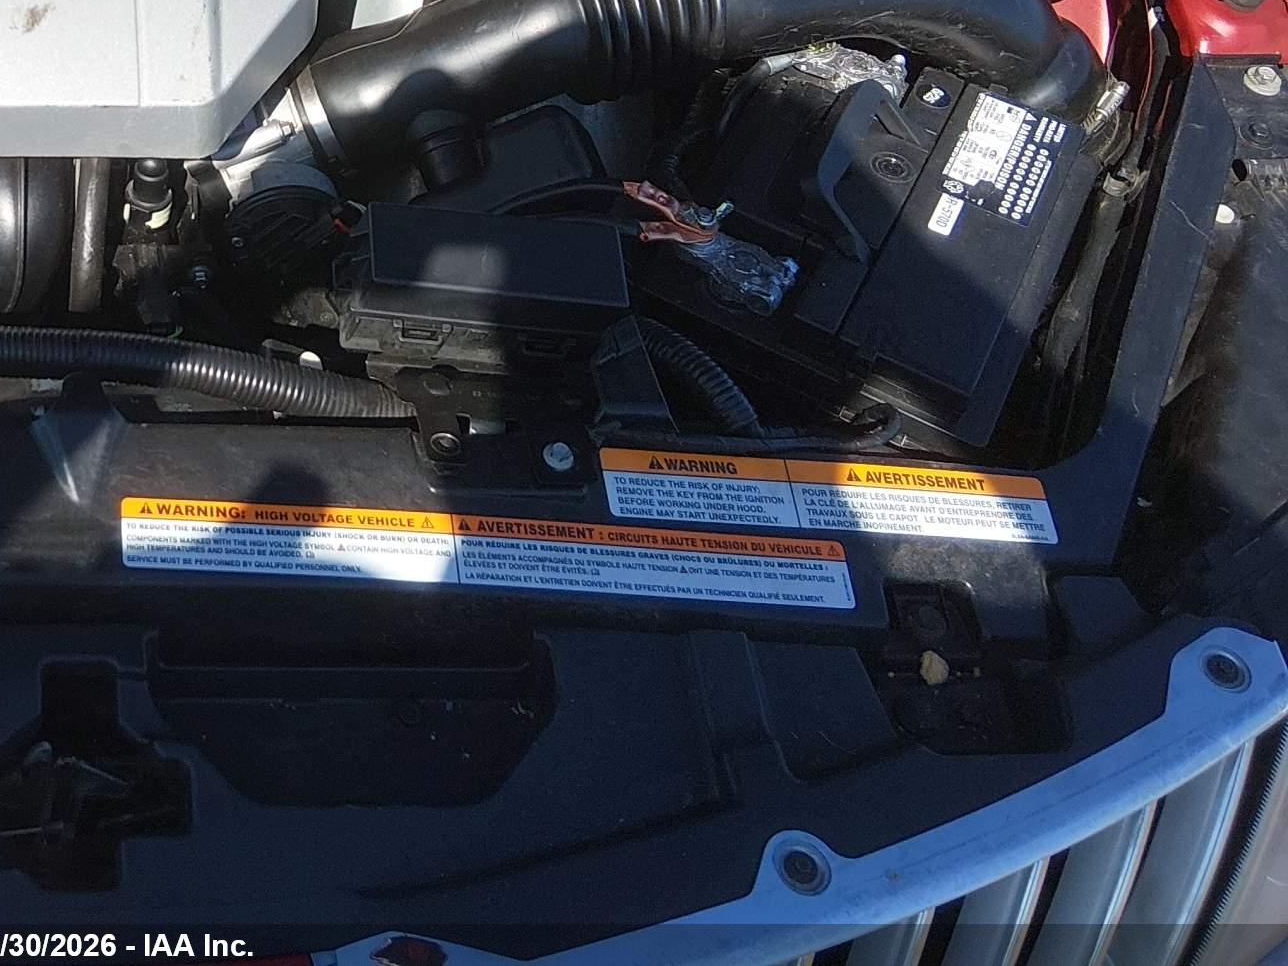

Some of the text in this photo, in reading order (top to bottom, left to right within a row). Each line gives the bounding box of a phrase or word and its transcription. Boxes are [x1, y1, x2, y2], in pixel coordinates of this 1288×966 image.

[664, 458, 738, 474] WARNING
[614, 476, 627, 485] TO
[629, 477, 664, 487] REDUCE
[668, 480, 685, 488] THE
[688, 481, 710, 490] RISK
[712, 483, 724, 491] OF
[866, 471, 984, 491] AVERTISSEMENT
[616, 487, 784, 505] REMOVE THE KEY FROM THE IGNITION
[618, 497, 655, 507] BEFORE
[657, 500, 701, 510] WORKING
[703, 502, 735, 512] UNDER
[802, 488, 828, 498] POUR
[871, 493, 887, 502] LES
[888, 494, 926, 504] RISQUES
[928, 497, 940, 505] DE
[996, 502, 1032, 512] RETIRER
[157, 503, 415, 527] WARNING: HIGH VOLTAGE VEHICLE
[620, 507, 654, 516] ENGINE
[656, 509, 674, 518] MAY
[677, 510, 706, 519] START
[804, 498, 816, 507] LA
[837, 501, 850, 509] DE
[909, 506, 937, 515] AVANT
[1016, 513, 1033, 521] DES
[806, 508, 848, 518] TRAVAUX
[850, 511, 873, 520] SOUS
[876, 513, 887, 521] LE
[925, 516, 937, 524] LE
[938, 517, 974, 527] MOTEUR
[976, 520, 997, 529] PEUT
[1000, 522, 1010, 530] SE
[1012, 522, 1046, 532] METTRE
[809, 518, 822, 526] EN
[477, 520, 594, 540] AVERTISSEMENT
[608, 533, 658, 545] CIRCUITS
[662, 536, 697, 547] HAUTE
[701, 538, 748, 551] TENSION
[751, 542, 766, 552] DU
[146, 546, 206, 554] TEMPERATURES
[194, 559, 241, 567] PERFORMED
[255, 562, 294, 570] QUALIFIED
[295, 563, 340, 572] PERSONNEL
[508, 564, 540, 572] DOIVENT
[586, 560, 621, 569] SYMBOLE
[622, 563, 646, 571] HAUTE
[648, 564, 678, 573] TENSION
[721, 569, 752, 578] TENSION
[581, 581, 612, 589] DOIVENT
[705, 589, 747, 598] TECHNICIEN
